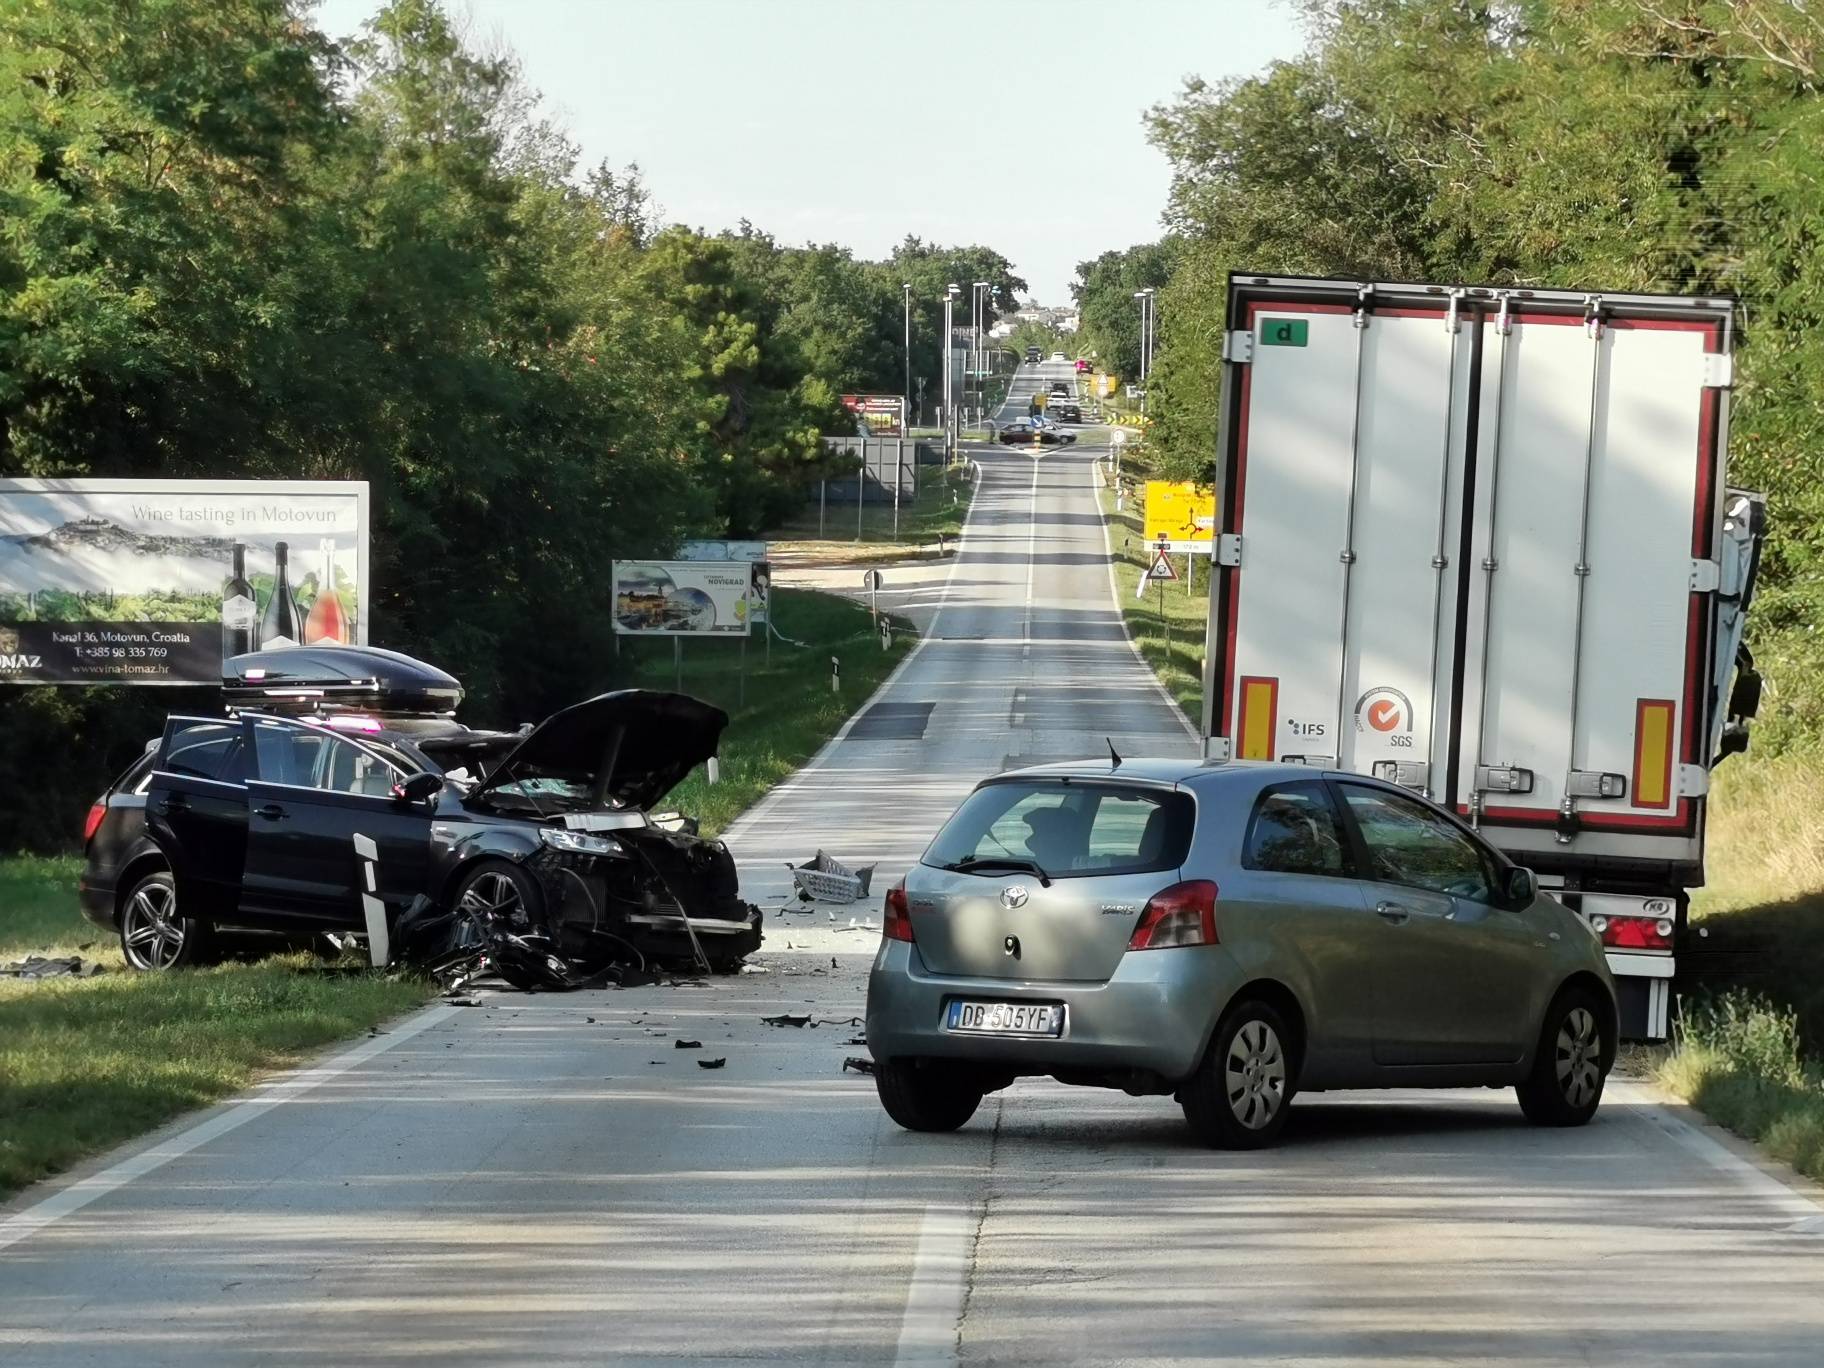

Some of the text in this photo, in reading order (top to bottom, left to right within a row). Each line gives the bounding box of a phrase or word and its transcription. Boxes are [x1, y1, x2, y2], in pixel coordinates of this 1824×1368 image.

[1277, 323, 1291, 341] d
[132, 504, 336, 526] Wine tasting in Motovun
[52, 631, 190, 644] Kanal 36, Motovun, Croatia
[85, 647, 110, 658] +385
[112, 647, 126, 658] 98
[128, 647, 146, 658] 335
[149, 647, 168, 658] 769
[0, 654, 43, 668] MAZ
[1302, 723, 1325, 736] IFS
[1390, 735, 1413, 747] SGS
[963, 1005, 985, 1027] DB
[991, 1005, 1048, 1030] 505YF
